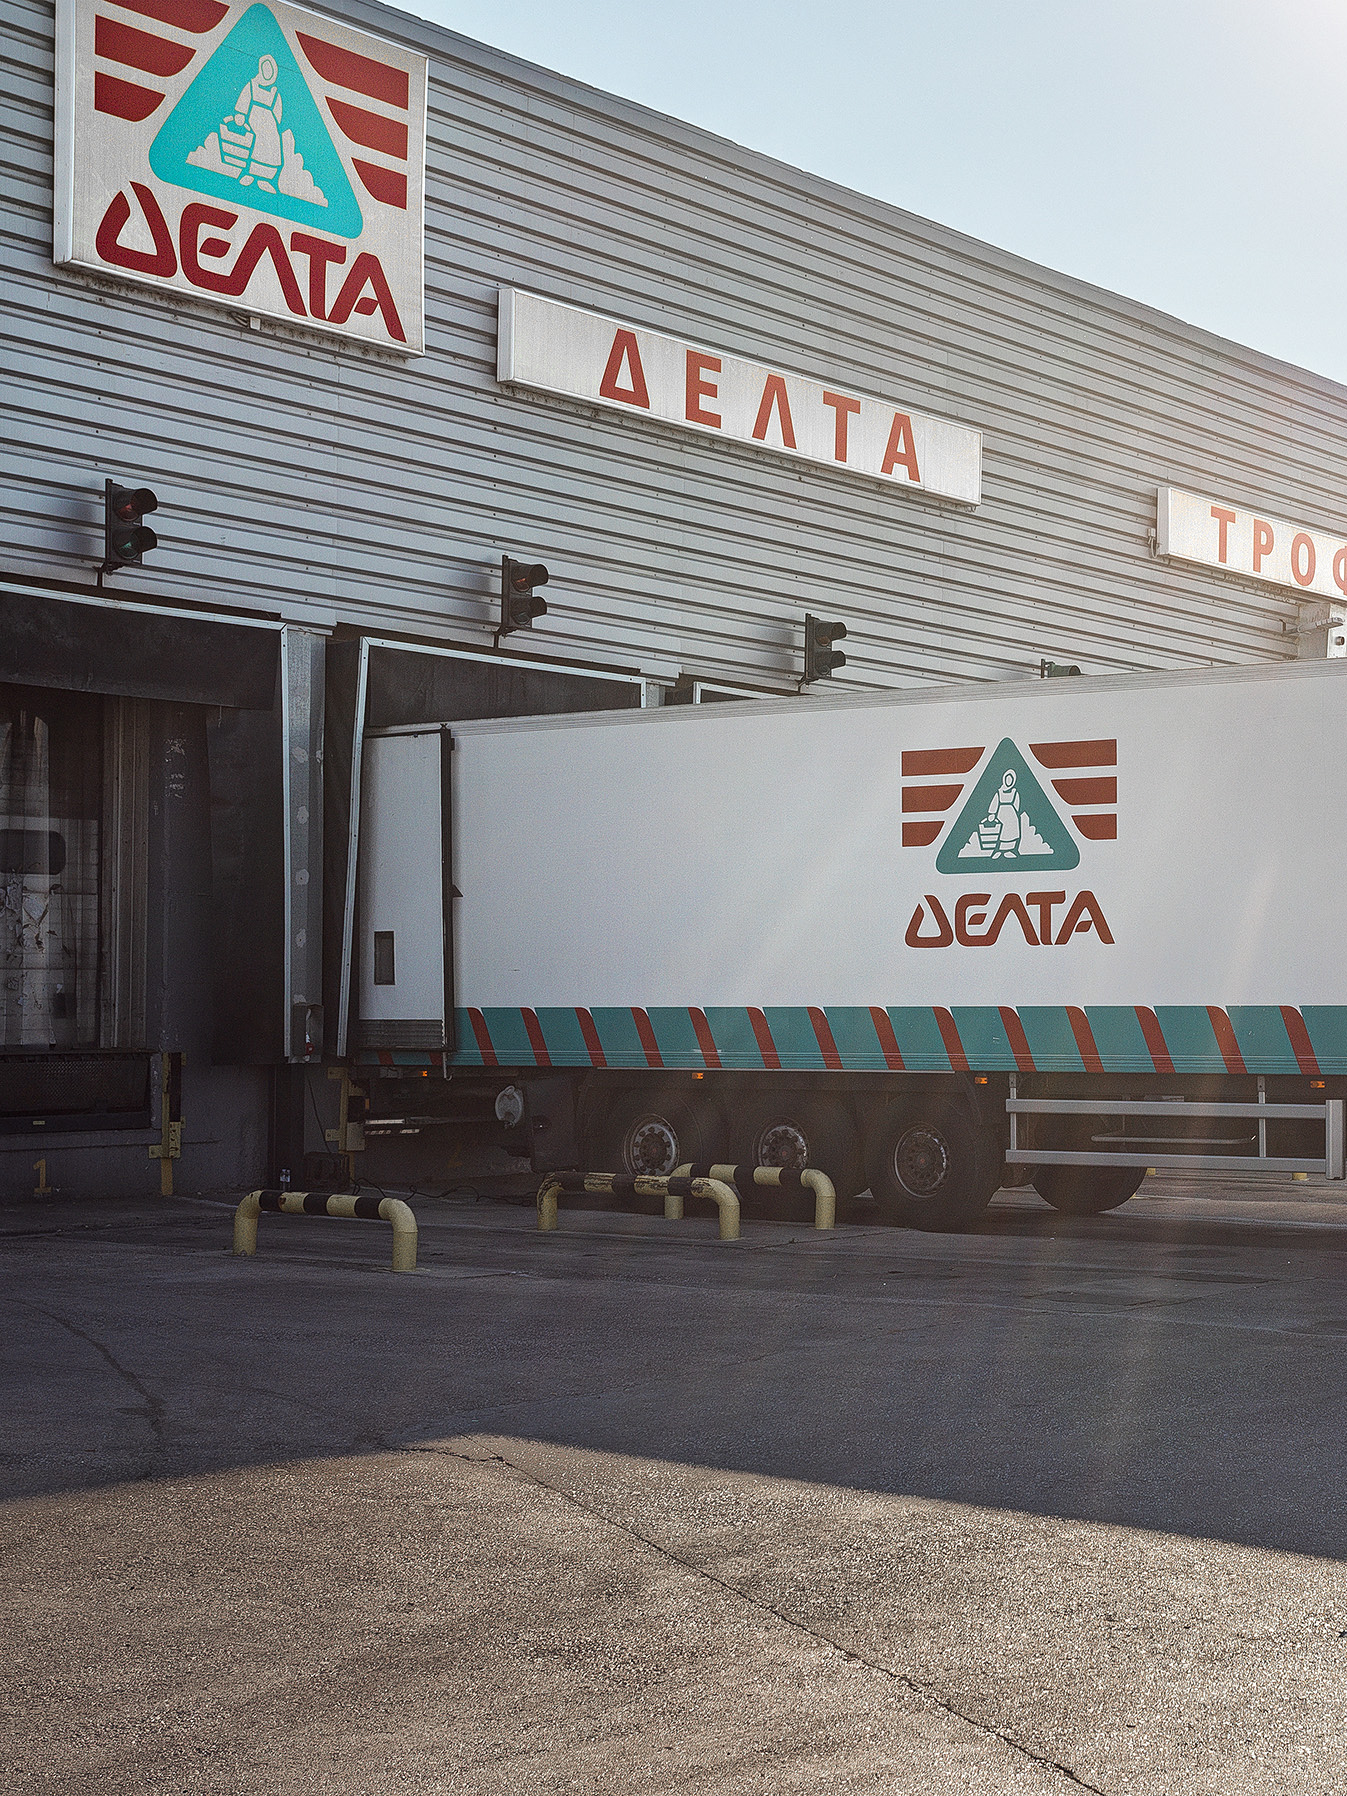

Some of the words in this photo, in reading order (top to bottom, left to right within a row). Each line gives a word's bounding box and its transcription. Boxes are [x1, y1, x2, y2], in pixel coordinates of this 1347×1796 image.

[95, 180, 407, 343] ΔΕΛΤΑ
[599, 328, 921, 483] ΔΕΛΤΑ
[904, 890, 1116, 949] ΔΕΛΤΑ
[32, 1158, 52, 1194] 1
